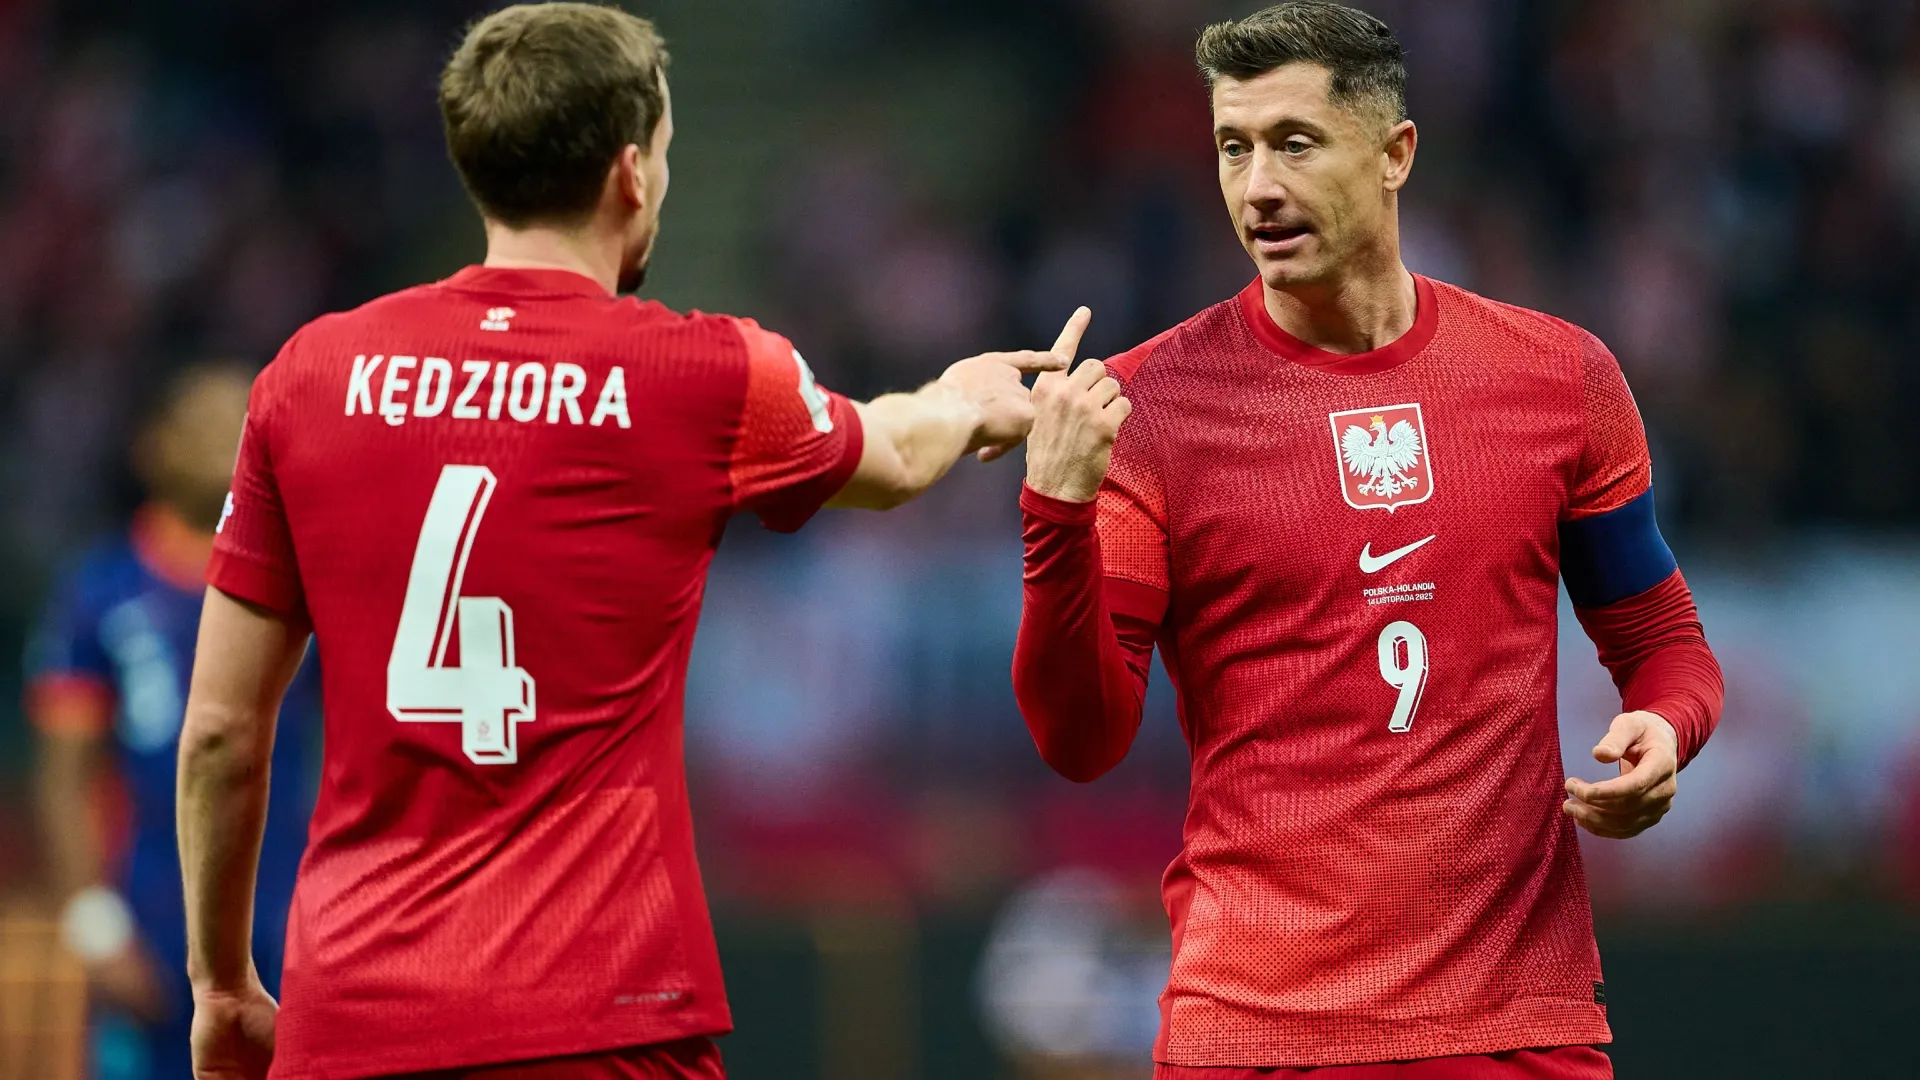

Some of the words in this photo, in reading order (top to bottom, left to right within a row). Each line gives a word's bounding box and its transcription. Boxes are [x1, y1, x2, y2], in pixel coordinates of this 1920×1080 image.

[345, 354, 632, 429] KĘDZIORA
[387, 464, 536, 765] 4
[1363, 582, 1436, 597] POLSKA-HOLANDIA
[1415, 592, 1434, 601] 2025
[1378, 620, 1429, 733] 9
